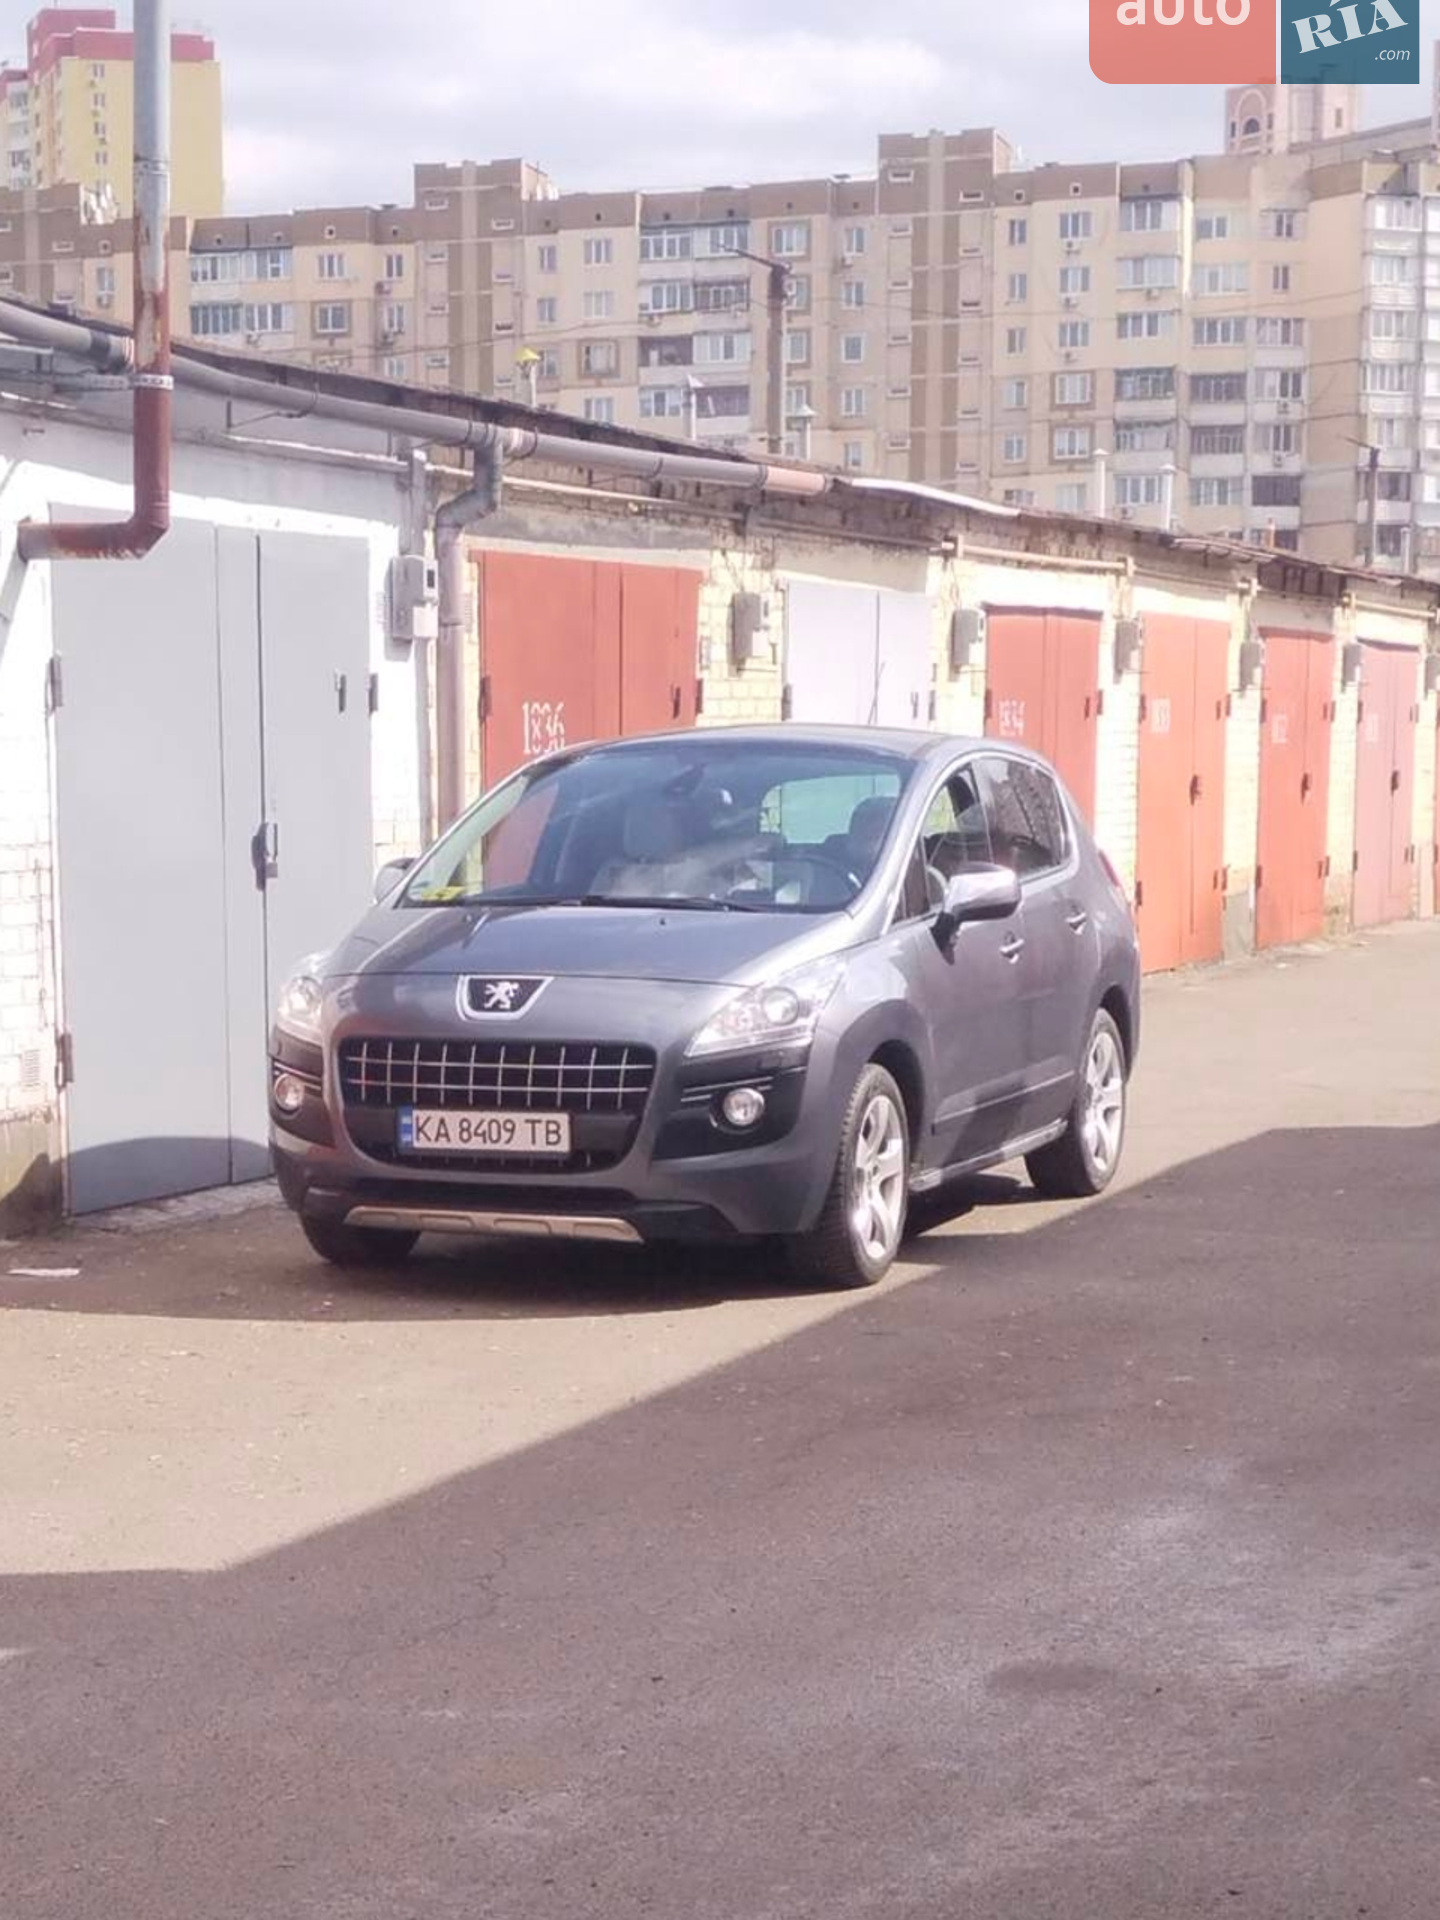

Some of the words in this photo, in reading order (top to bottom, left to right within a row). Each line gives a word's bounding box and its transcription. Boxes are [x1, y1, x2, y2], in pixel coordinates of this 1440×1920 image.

[522, 701, 565, 755] 1836
[415, 1115, 451, 1143] KA
[458, 1117, 517, 1144] 8409
[524, 1119, 562, 1146] TB
